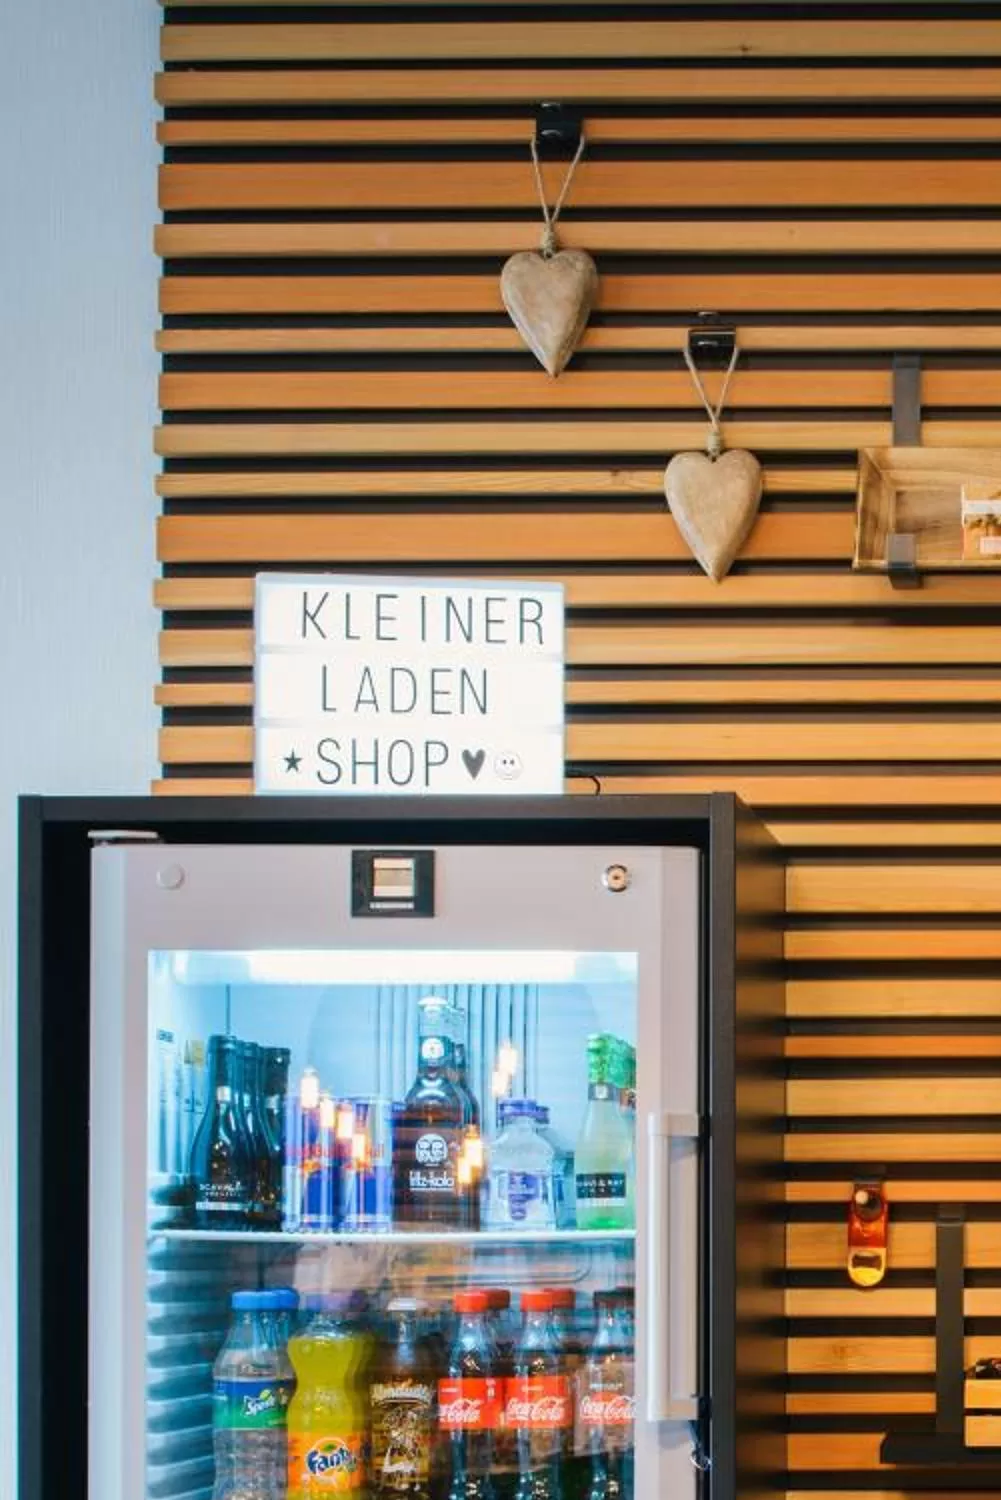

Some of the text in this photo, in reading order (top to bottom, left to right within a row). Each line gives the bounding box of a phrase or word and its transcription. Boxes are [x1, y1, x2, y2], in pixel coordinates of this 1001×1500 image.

[301, 591, 544, 645] KLEINER
[321, 664, 488, 715] LADEN
[316, 738, 449, 786] SHOP
